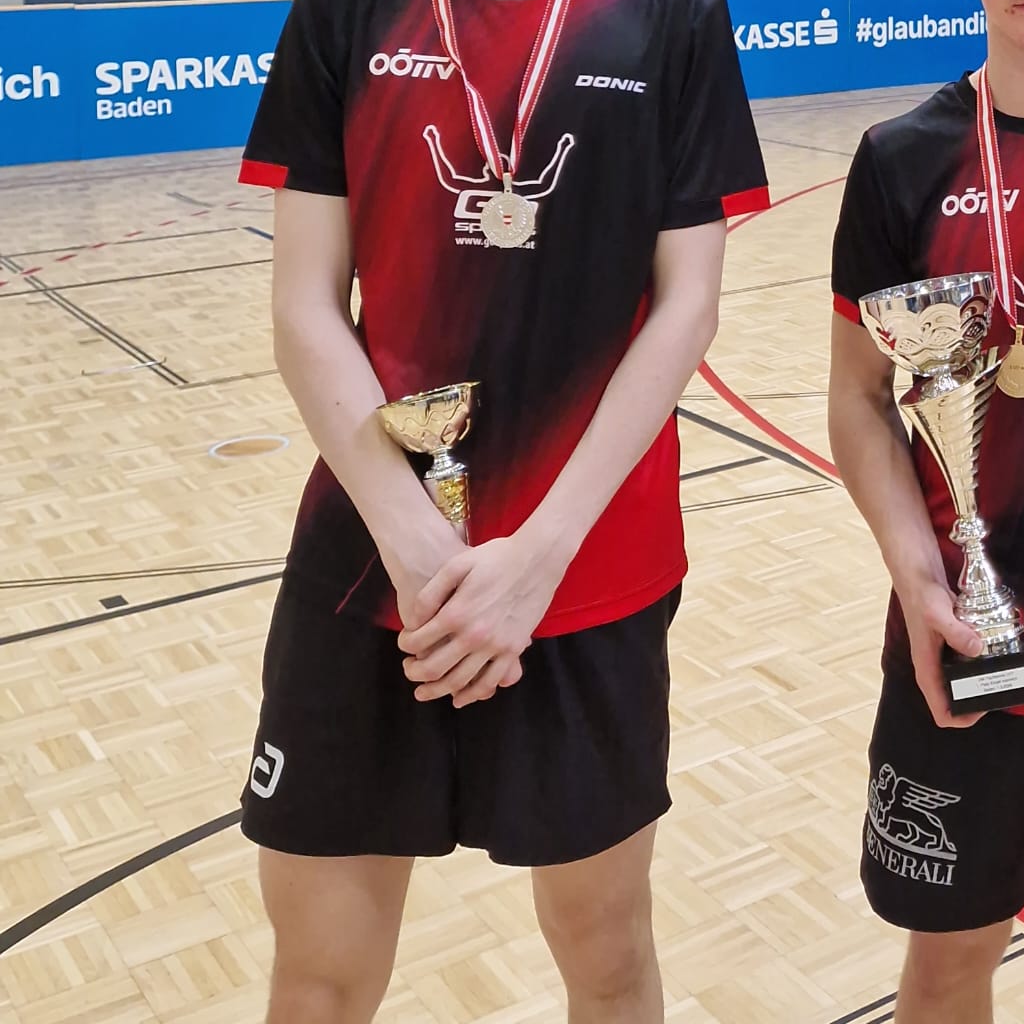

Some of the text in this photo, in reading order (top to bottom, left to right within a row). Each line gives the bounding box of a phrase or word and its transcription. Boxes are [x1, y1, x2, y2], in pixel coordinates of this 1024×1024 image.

[856, 10, 987, 48] #glaubandi
[95, 52, 275, 95] SPARKAS
[575, 74, 647, 94] DONIC
[96, 97, 172, 120] Baden
